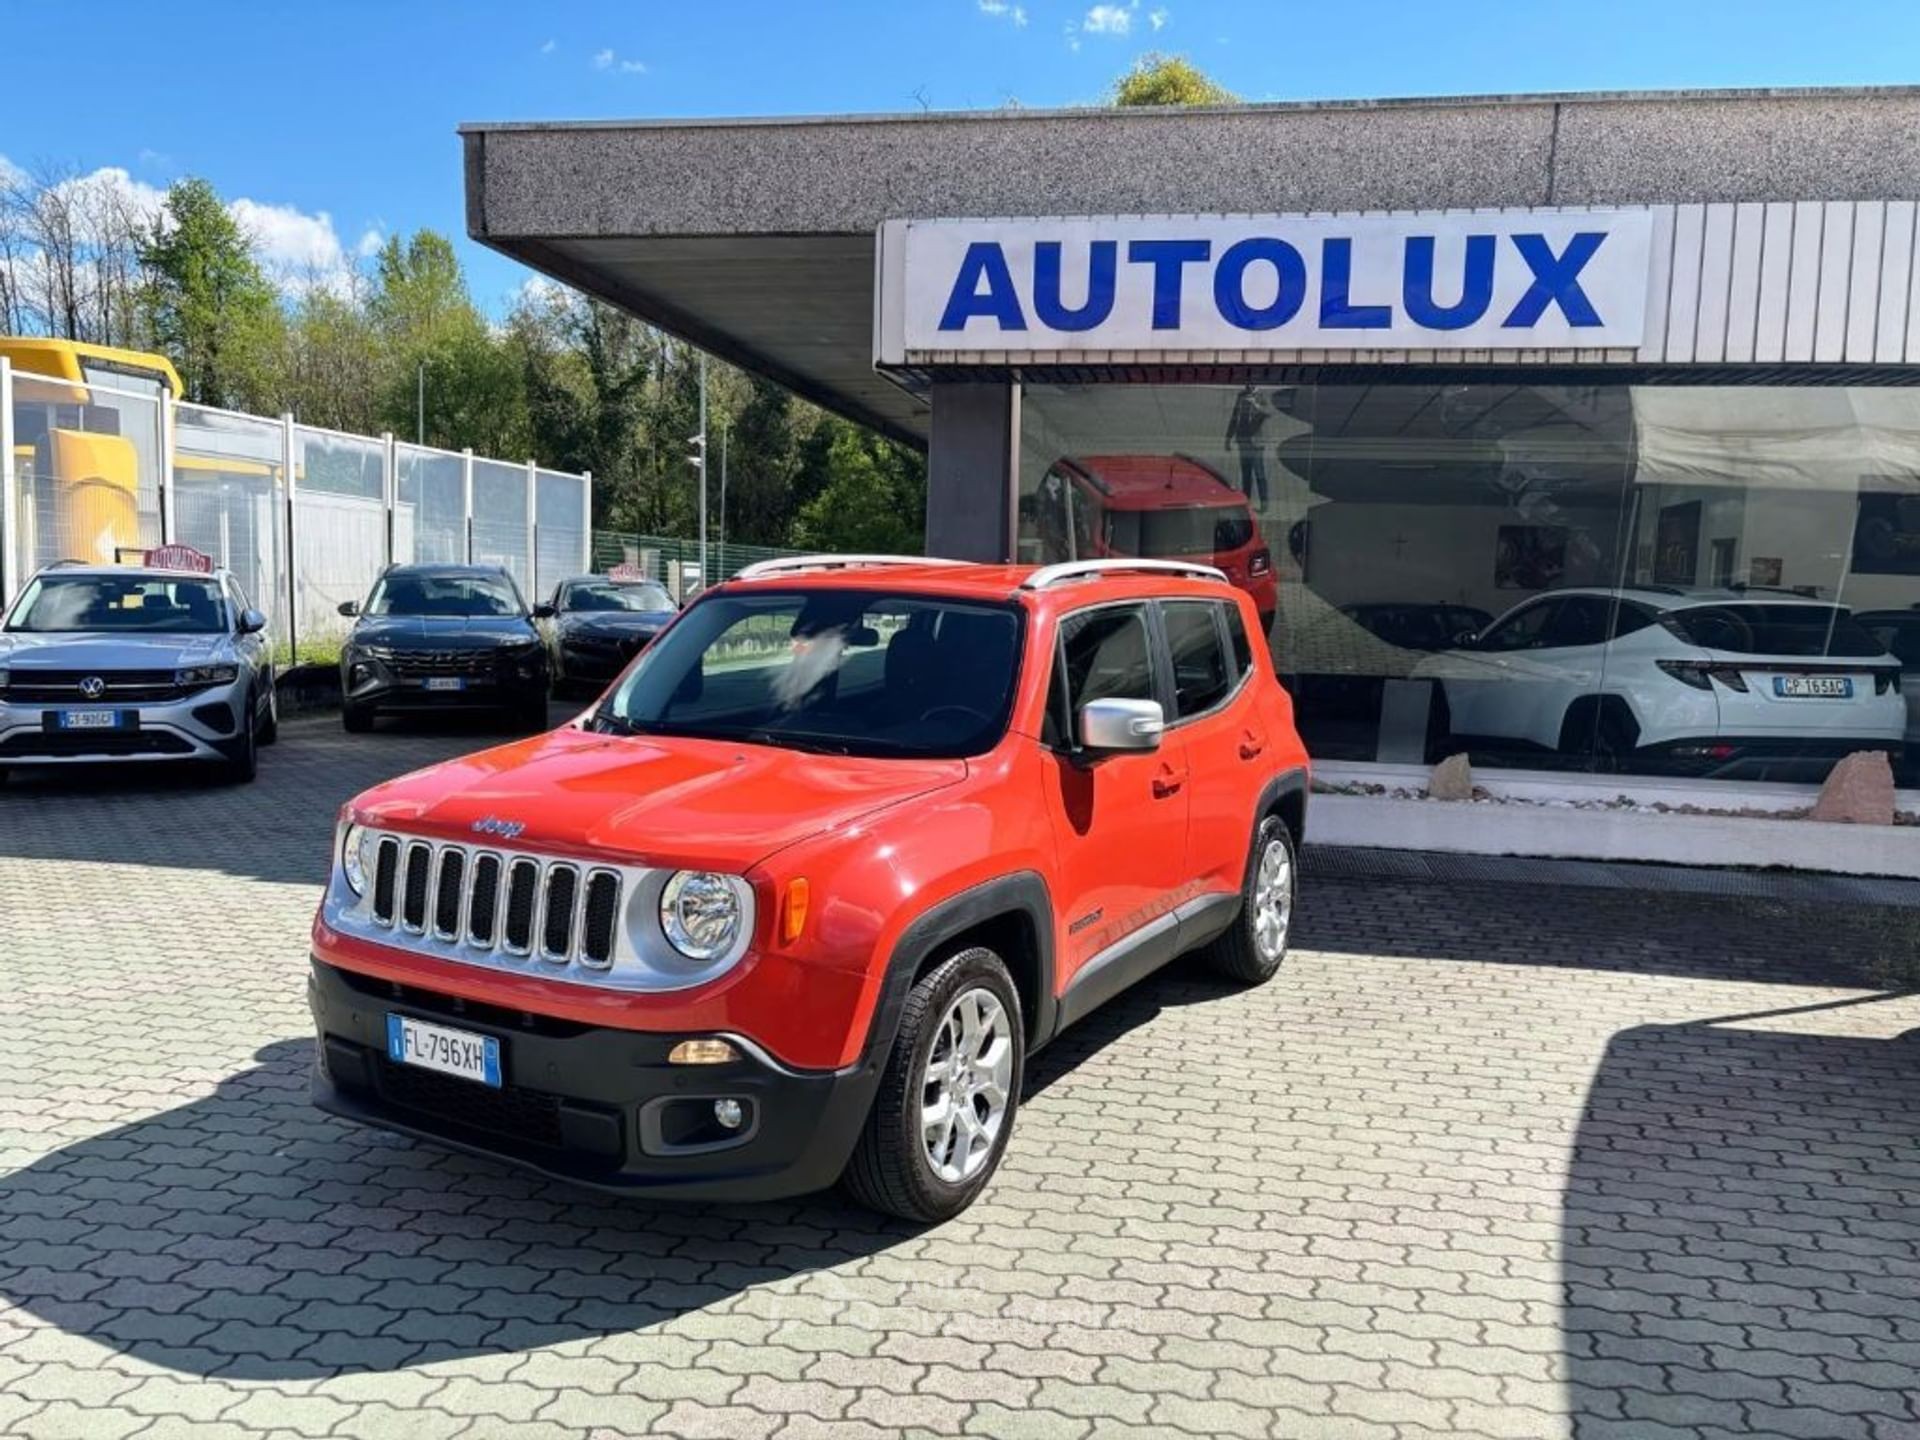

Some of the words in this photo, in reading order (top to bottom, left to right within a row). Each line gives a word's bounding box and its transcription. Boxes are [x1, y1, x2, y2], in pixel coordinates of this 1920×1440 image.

[938, 232, 1610, 332] AUTOLUX
[149, 547, 207, 573] AUTOMATICO
[472, 815, 526, 839] Jeep
